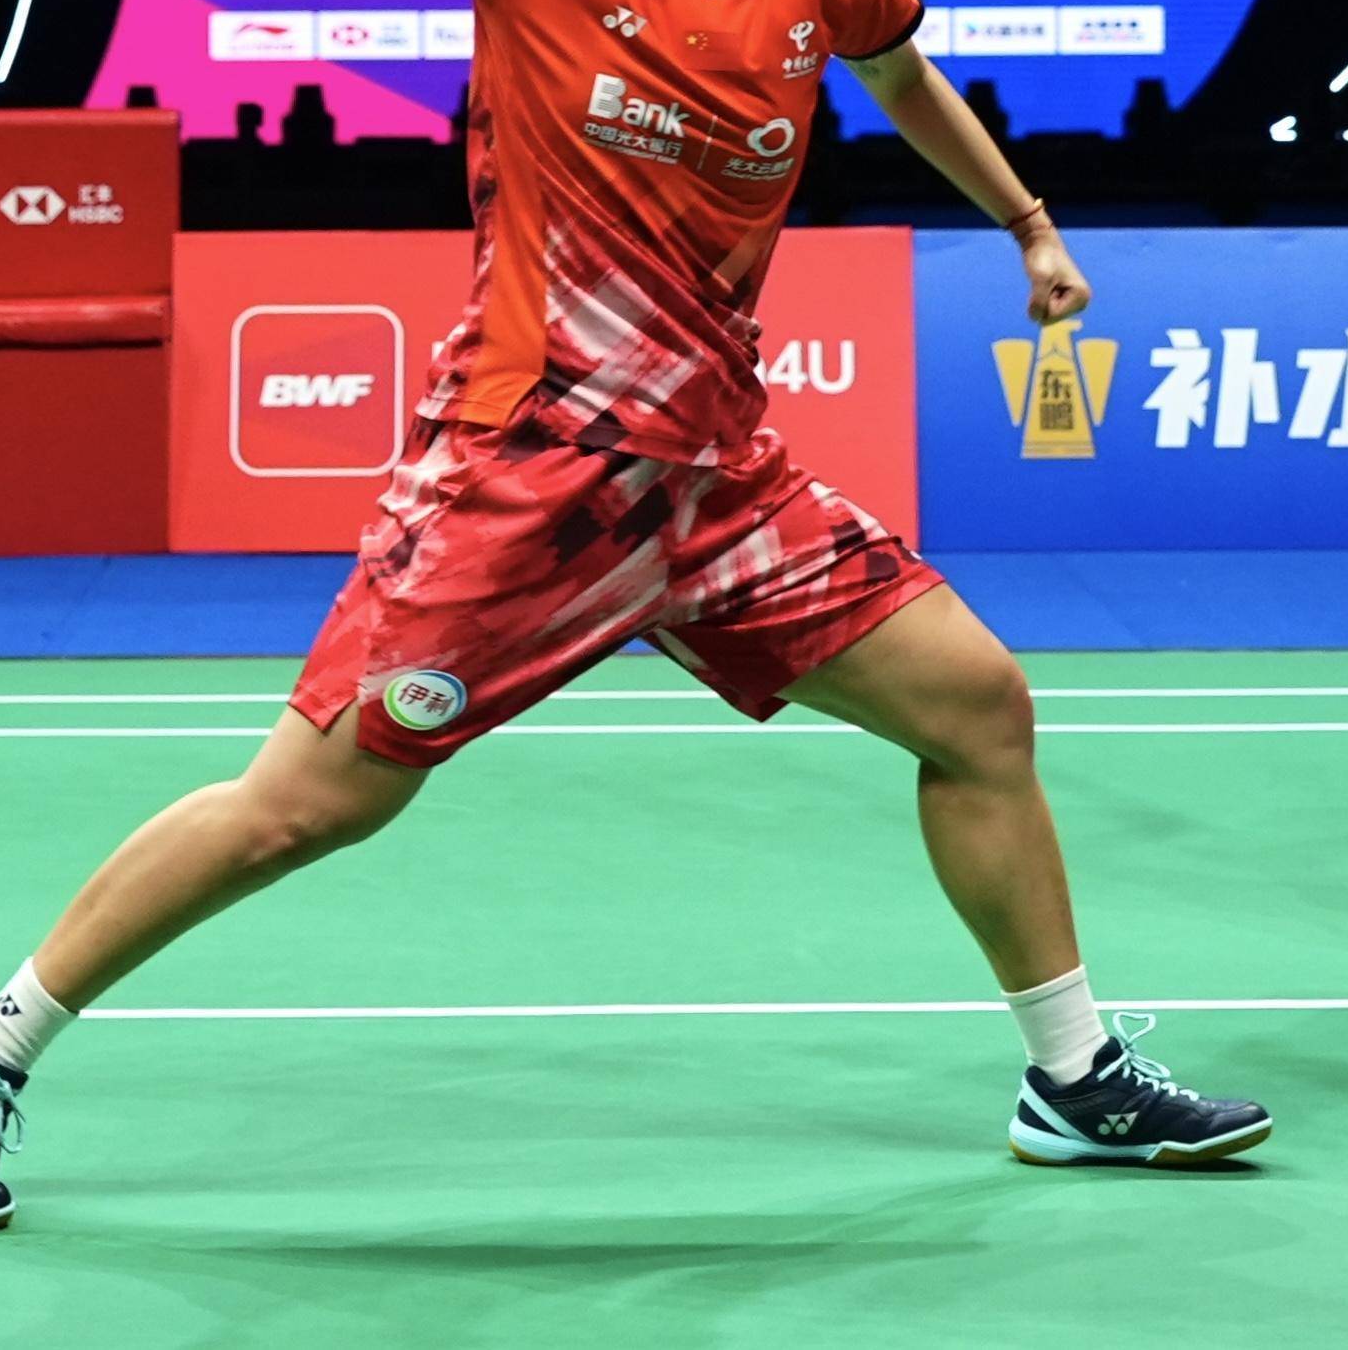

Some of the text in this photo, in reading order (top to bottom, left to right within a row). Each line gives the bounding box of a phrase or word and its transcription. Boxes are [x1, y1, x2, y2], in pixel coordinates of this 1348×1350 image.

[588, 73, 691, 138] Bank
[259, 373, 376, 408] BWF
[752, 339, 856, 395] 4U
